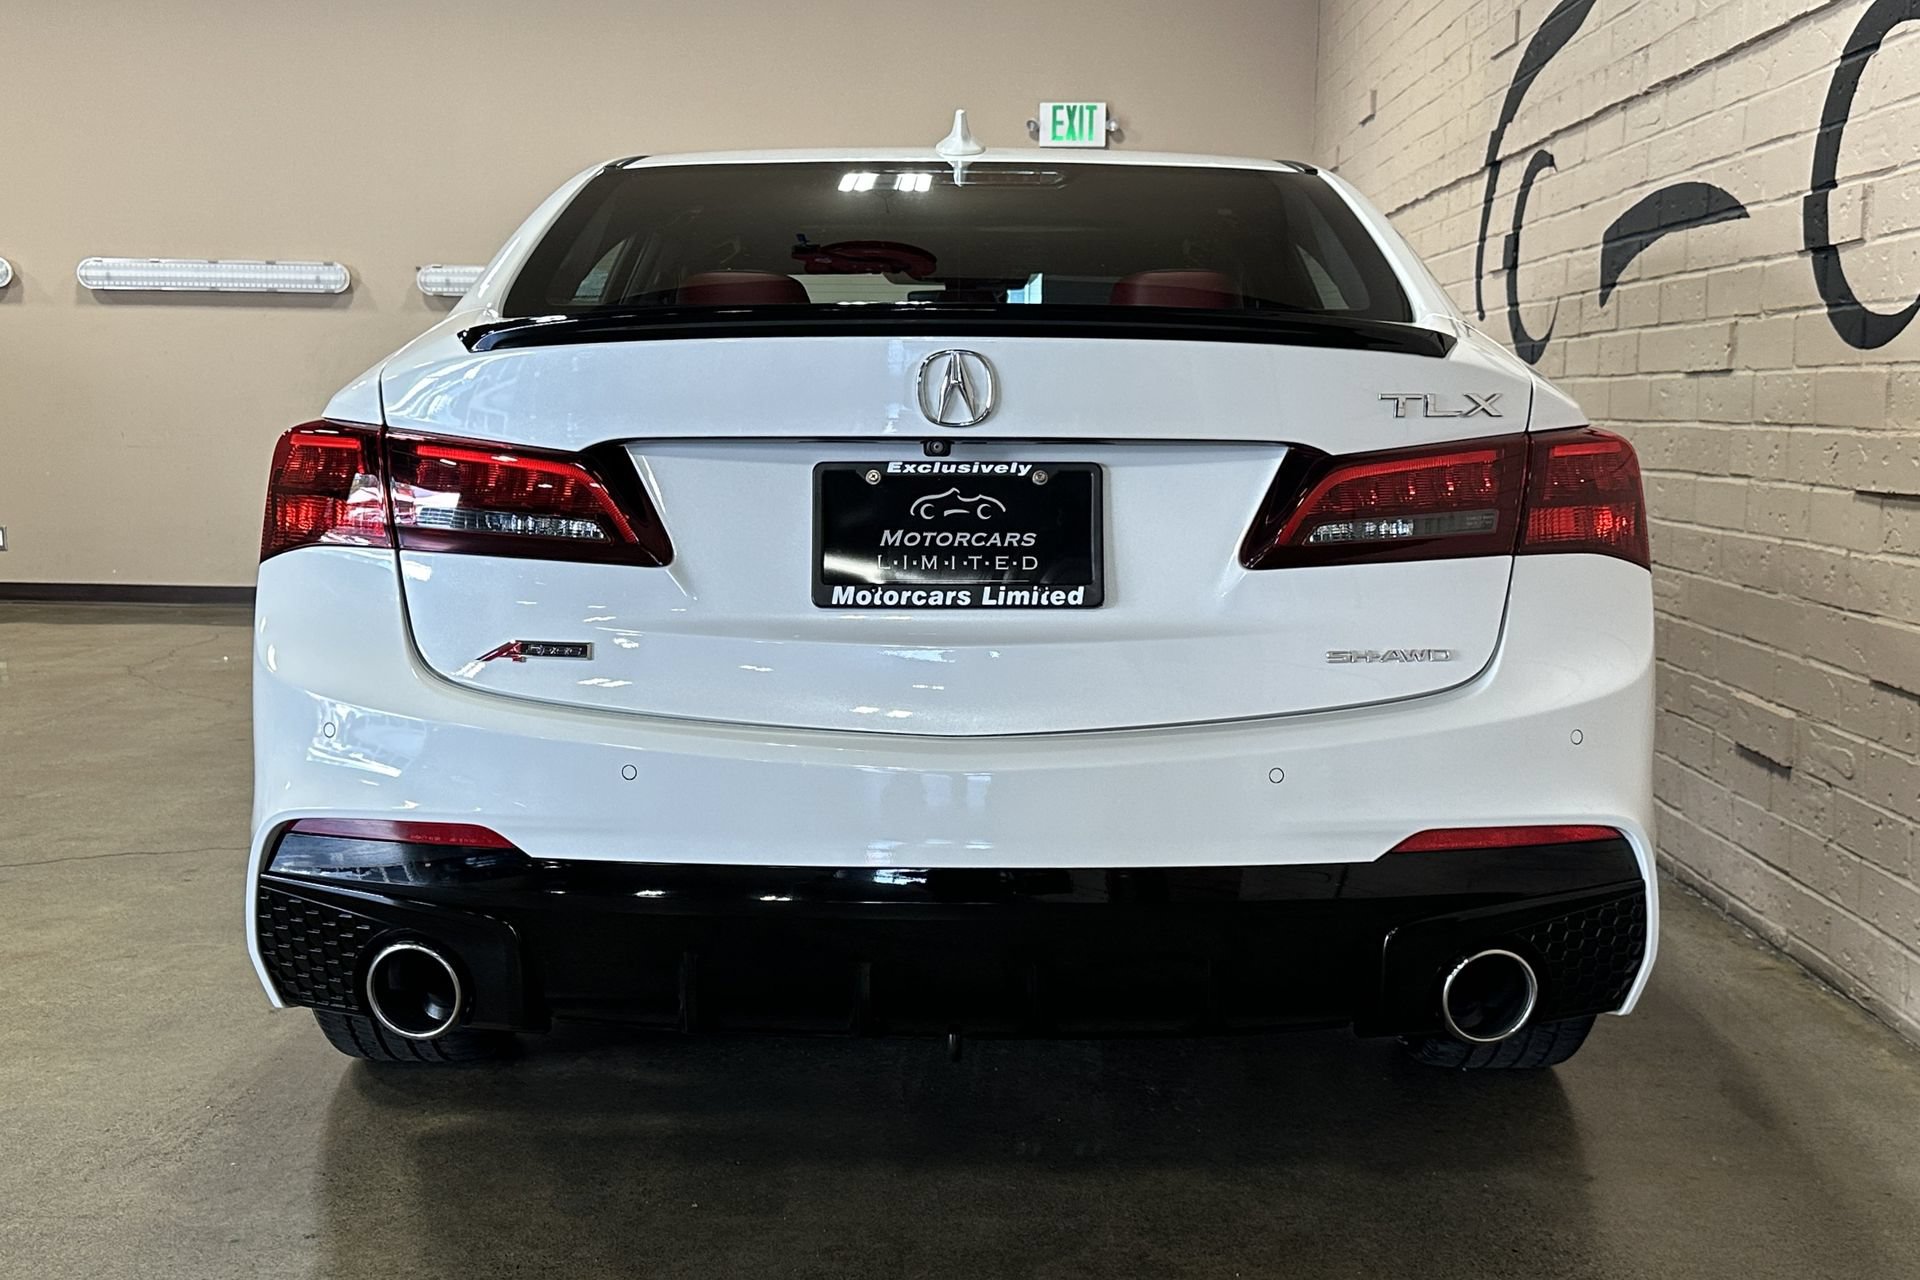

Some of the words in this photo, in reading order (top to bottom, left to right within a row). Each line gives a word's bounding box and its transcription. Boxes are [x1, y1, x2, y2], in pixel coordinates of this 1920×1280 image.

[1051, 104, 1098, 141] EXIT
[1377, 393, 1503, 418] TLX
[887, 462, 1032, 475] Exclusively
[832, 586, 971, 605] Motorcars
[982, 586, 1084, 605] Limited
[1326, 649, 1453, 664] SH-AWD
